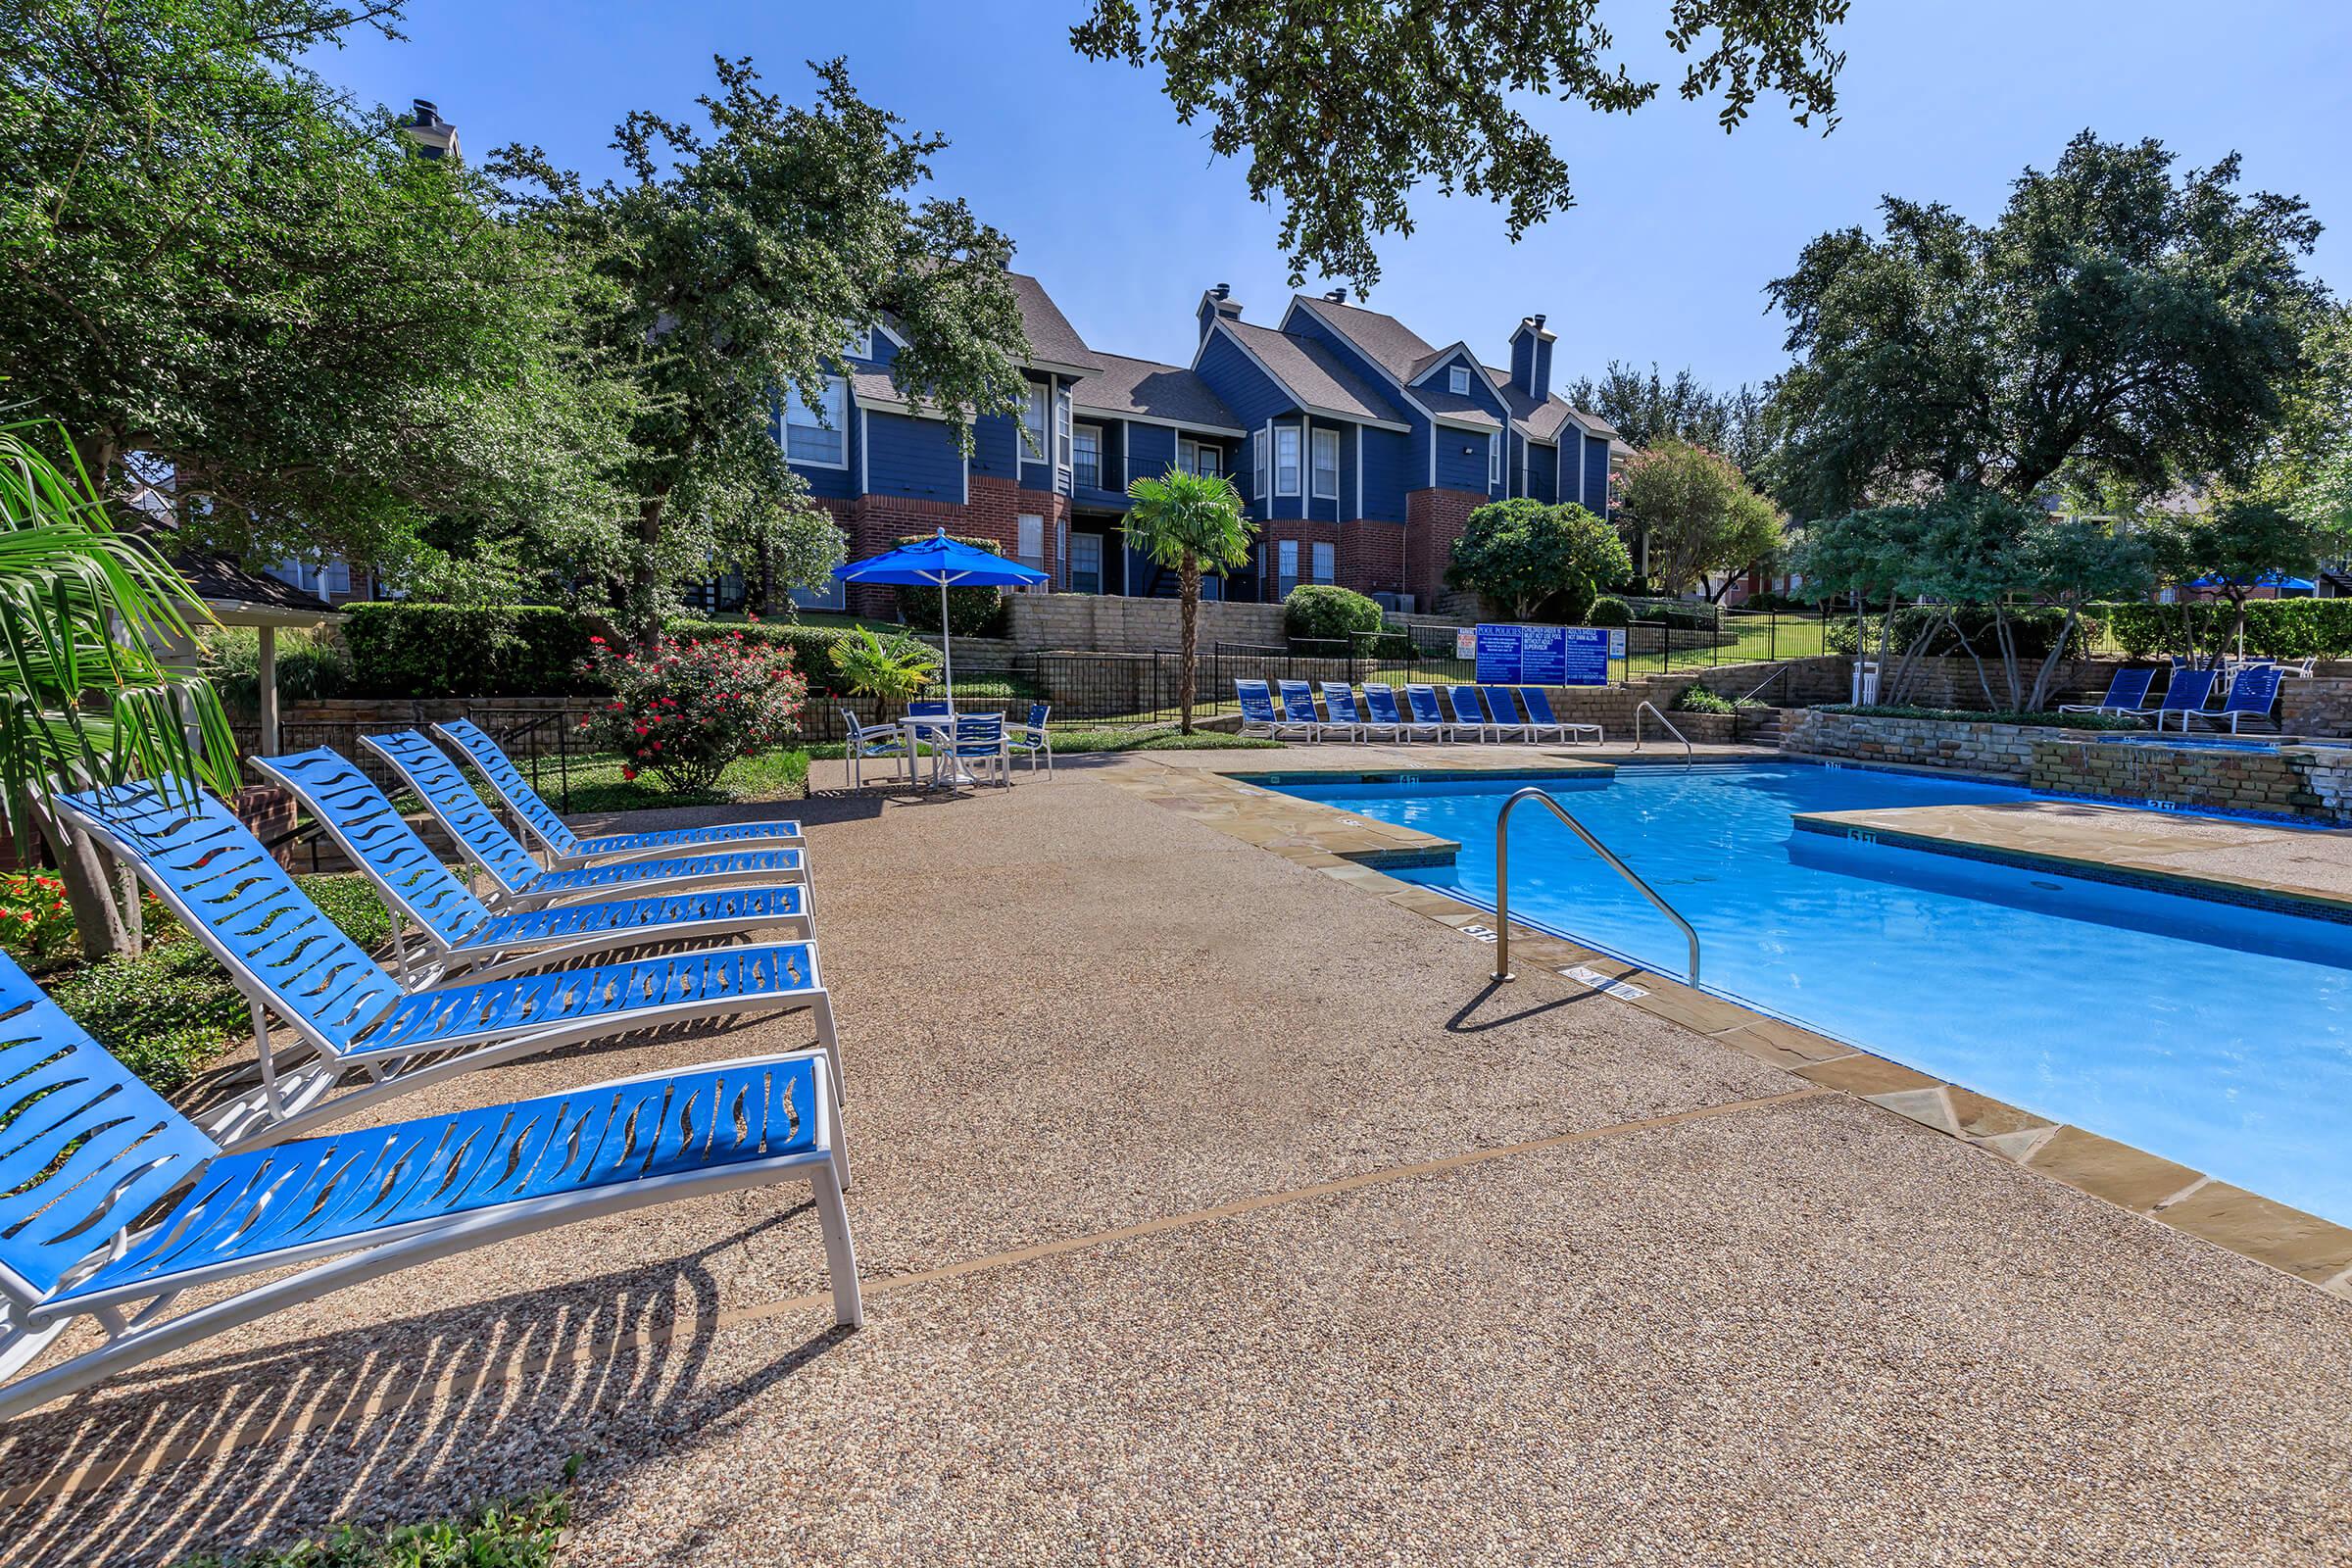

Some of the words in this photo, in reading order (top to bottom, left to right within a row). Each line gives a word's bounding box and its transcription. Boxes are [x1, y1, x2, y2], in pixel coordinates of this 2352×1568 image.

[1479, 626, 1494, 636] POOL
[1494, 627, 1522, 637] POLICIES
[1862, 831, 1876, 843] FT
